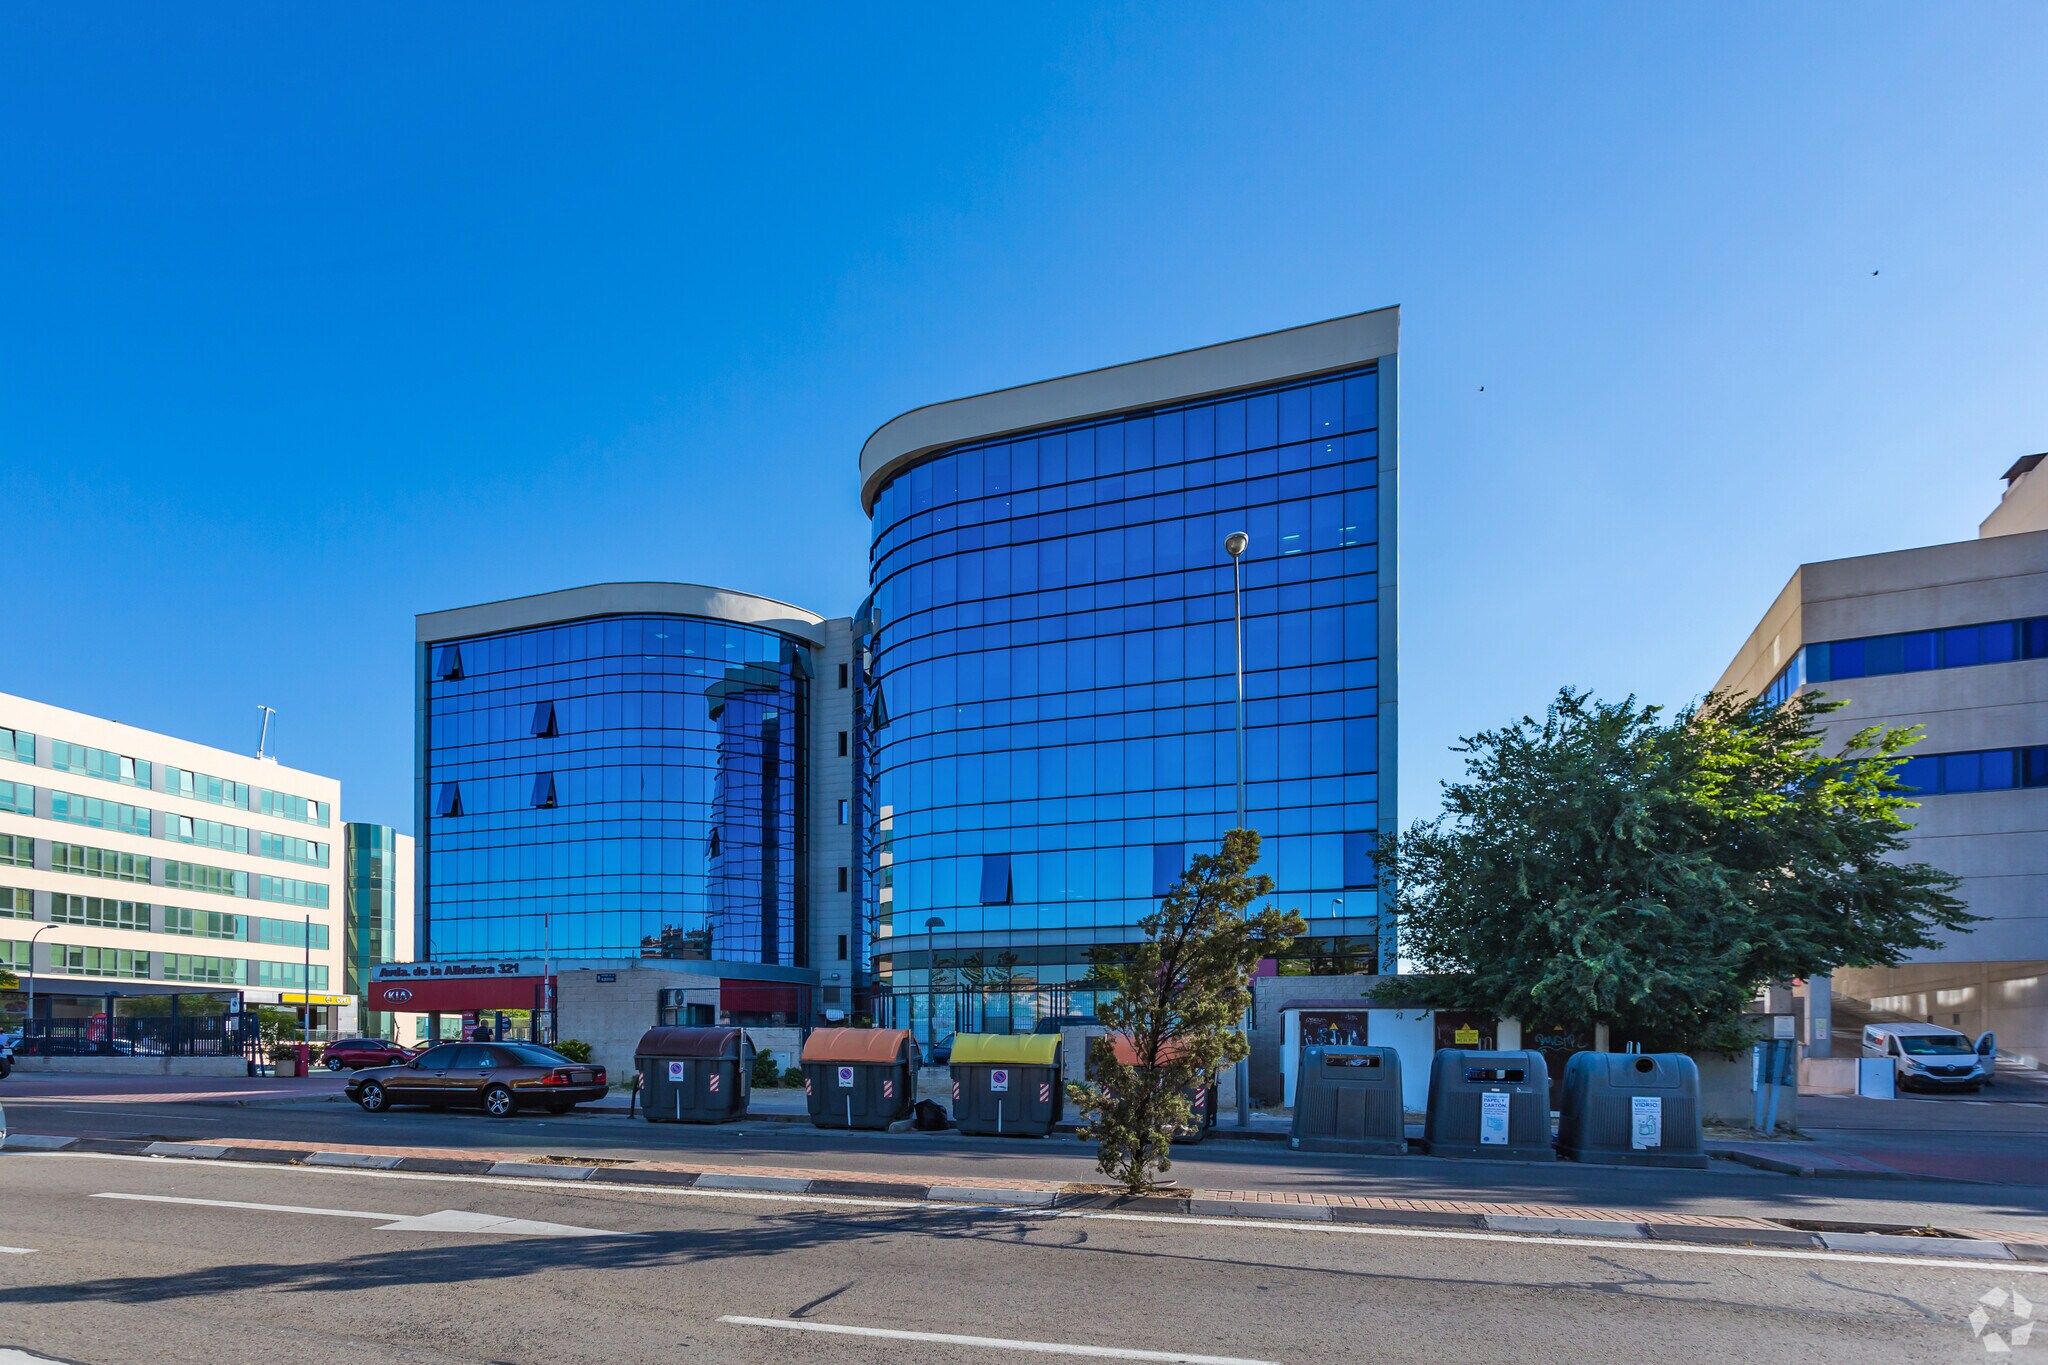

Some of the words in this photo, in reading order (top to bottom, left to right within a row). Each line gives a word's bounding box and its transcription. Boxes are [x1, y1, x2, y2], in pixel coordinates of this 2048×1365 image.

[379, 967, 411, 977] Avda.
[413, 966, 428, 976] de
[430, 966, 442, 976] la
[444, 964, 495, 975] Albufera
[498, 963, 519, 974] 321
[387, 990, 408, 1001] KIA
